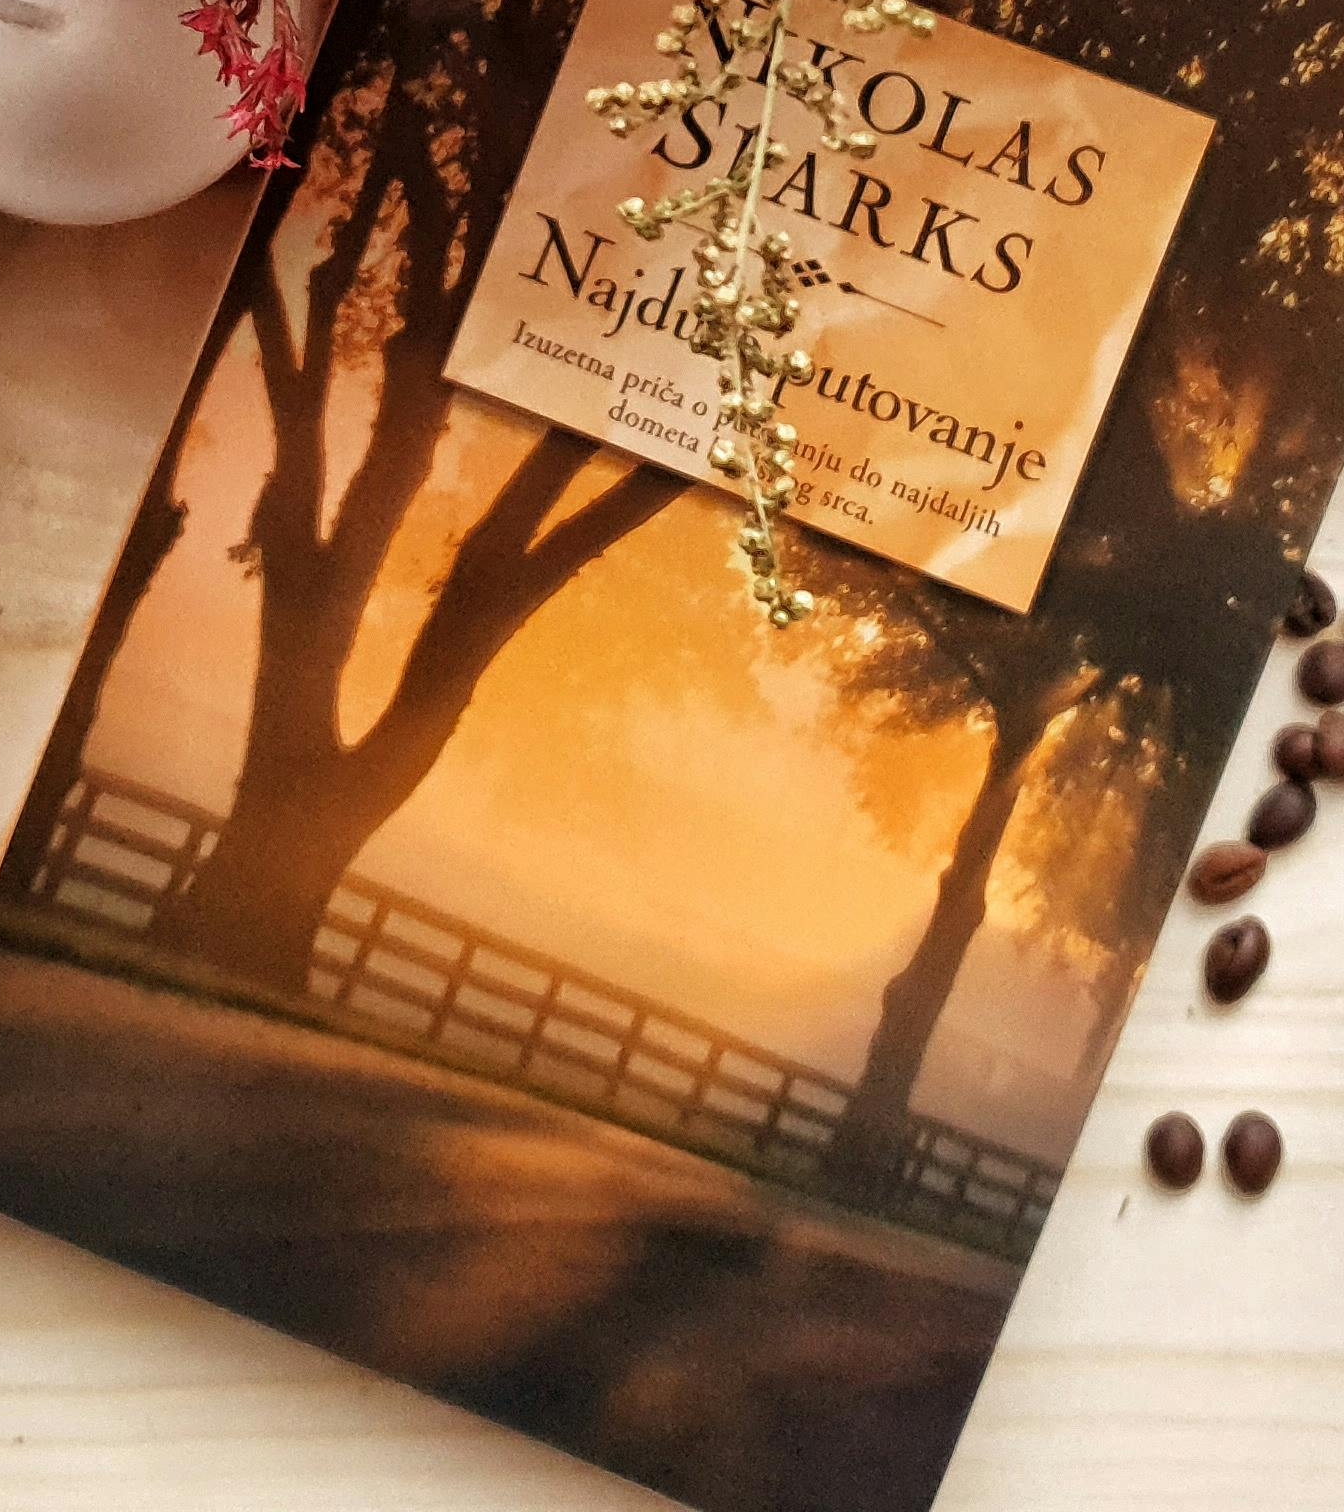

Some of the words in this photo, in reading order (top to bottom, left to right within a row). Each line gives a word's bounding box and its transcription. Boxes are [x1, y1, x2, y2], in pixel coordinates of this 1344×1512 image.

[518, 211, 762, 363] Najdu
[771, 364, 1047, 491] putovanje
[511, 320, 616, 381] Izuzetna
[619, 371, 685, 409] priča
[692, 401, 708, 416] o
[712, 410, 843, 473] putnju
[849, 457, 883, 488] do
[890, 479, 1004, 538] najdaljih
[608, 399, 700, 453] dometa
[823, 490, 874, 526] srca.
